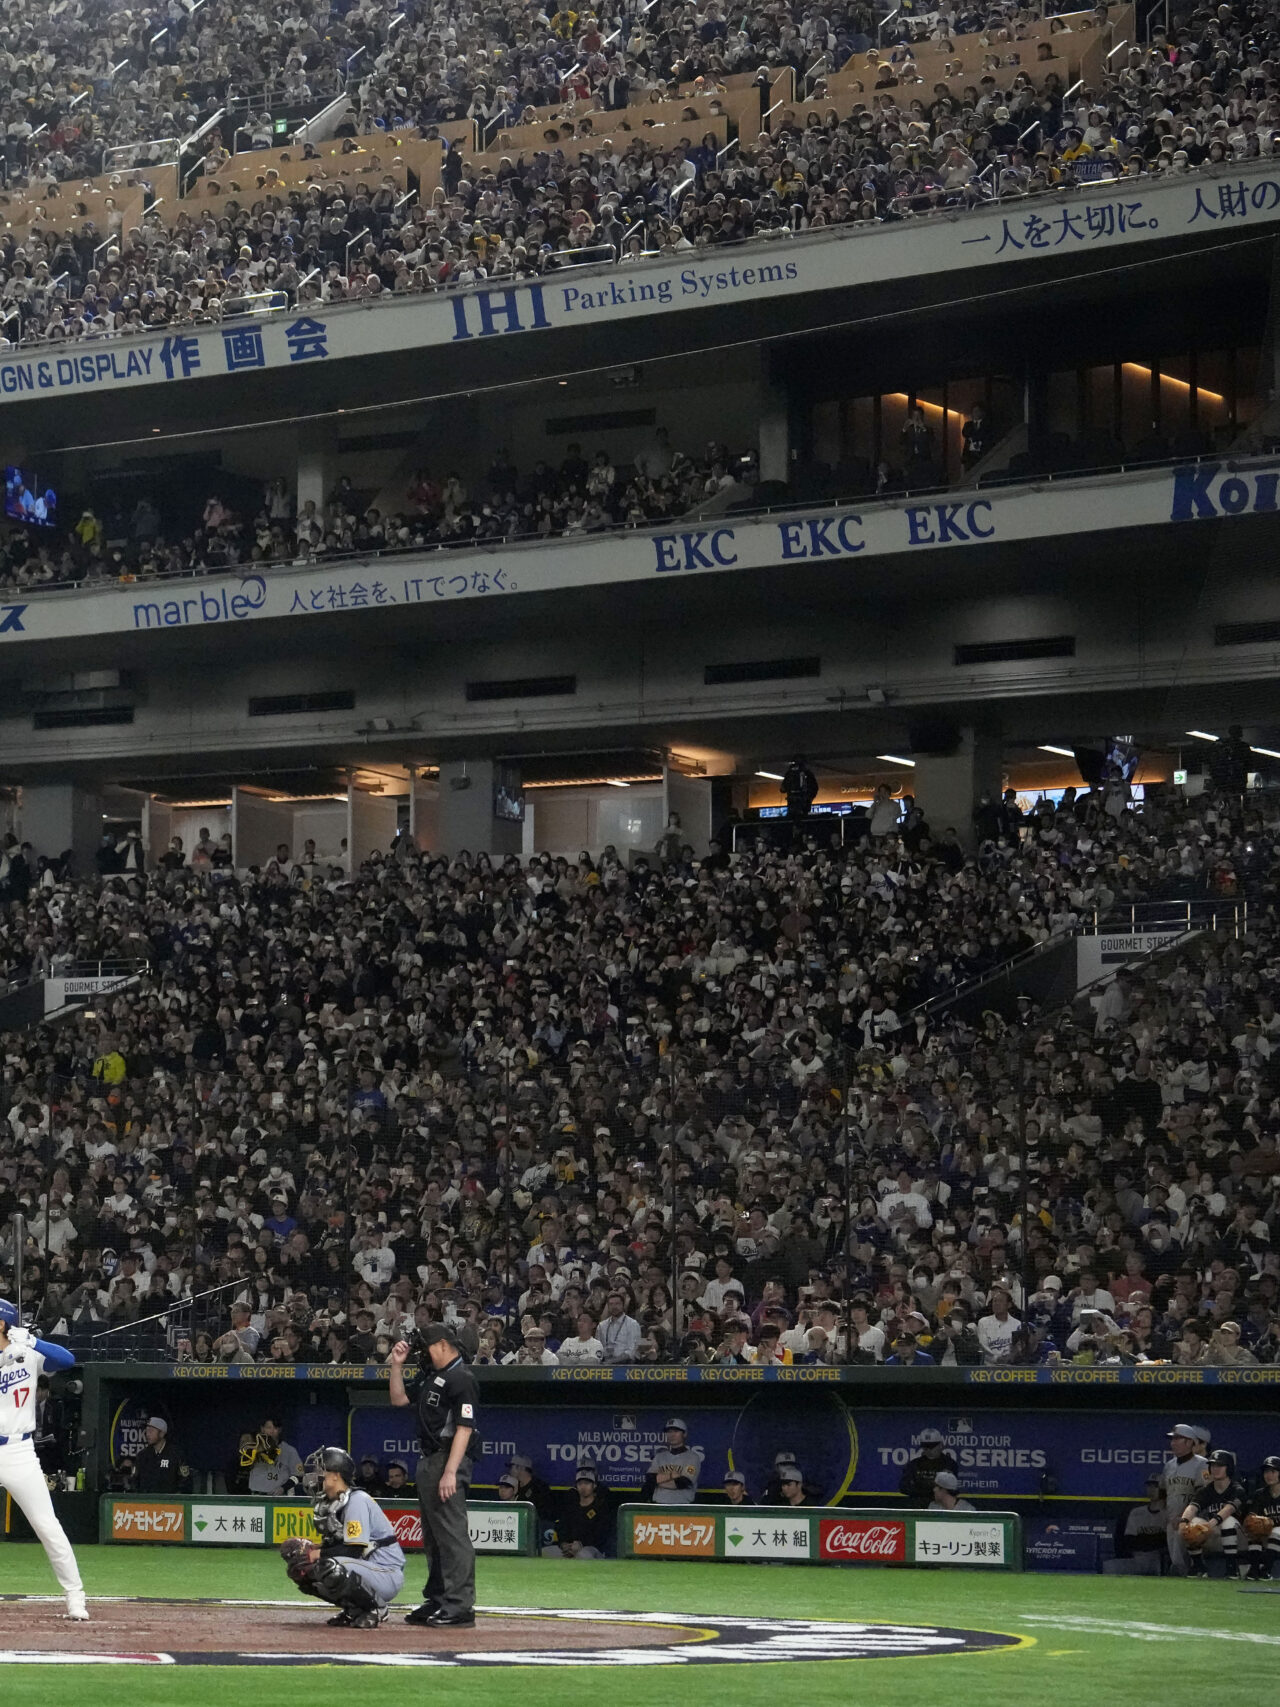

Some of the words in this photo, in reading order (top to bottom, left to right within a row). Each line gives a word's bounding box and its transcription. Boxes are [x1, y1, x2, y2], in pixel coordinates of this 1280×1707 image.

[961, 202, 1159, 254] 一人を大切に。
[1187, 180, 1280, 224] 人財の
[450, 283, 552, 340] IHI
[562, 279, 672, 311] Parking
[681, 261, 798, 298] Systems
[37, 361, 54, 389] &
[57, 348, 153, 386] DISPLAY
[904, 500, 995, 545] EKC
[777, 514, 866, 559] EKC
[652, 529, 739, 572] EKC
[289, 568, 519, 614] 人と社会を、ITでつなぐ。
[133, 582, 259, 628] marble
[1101, 937, 1143, 951] GOURMET
[64, 981, 98, 993] GOURMET
[173, 1366, 193, 1378] KEY
[194, 1366, 228, 1378] COFFEE
[239, 1367, 258, 1378] KEY
[259, 1367, 296, 1378] COFFEE
[307, 1367, 326, 1378] KEY
[327, 1367, 364, 1378] COFFEE
[376, 1367, 393, 1379] KE
[551, 1368, 573, 1380] KEY
[574, 1368, 614, 1380] COFFEE
[625, 1368, 647, 1380] KEY
[648, 1368, 688, 1380] COFFEE
[700, 1368, 722, 1380] KEY
[722, 1368, 764, 1380] COFFEE
[776, 1368, 799, 1381] KEY
[799, 1368, 841, 1381] COFFEE
[970, 1370, 993, 1382] KEY
[994, 1370, 1038, 1382] COFFEE
[1050, 1370, 1074, 1382] KEY
[1075, 1370, 1120, 1382] COFFEE
[1133, 1370, 1158, 1382] KEY
[1158, 1370, 1204, 1382] COFFEE
[1217, 1370, 1242, 1382] KEY
[1242, 1370, 1280, 1382] COFFE
[13, 1387, 30, 1408] 17
[578, 1432, 600, 1442] MLB
[602, 1432, 642, 1443] WORLD
[980, 1435, 1011, 1447] TOUR
[547, 1444, 621, 1461] TOKYO
[960, 1449, 1047, 1468] SERIES
[113, 1509, 183, 1532] タケモトピアノ
[215, 1516, 264, 1533] 大林組
[634, 1523, 714, 1547] タケモトピアノ
[752, 1529, 808, 1547] 大林組
[825, 1525, 901, 1555] Coca-Cola
[918, 1540, 1001, 1557] キョーリン製薬
